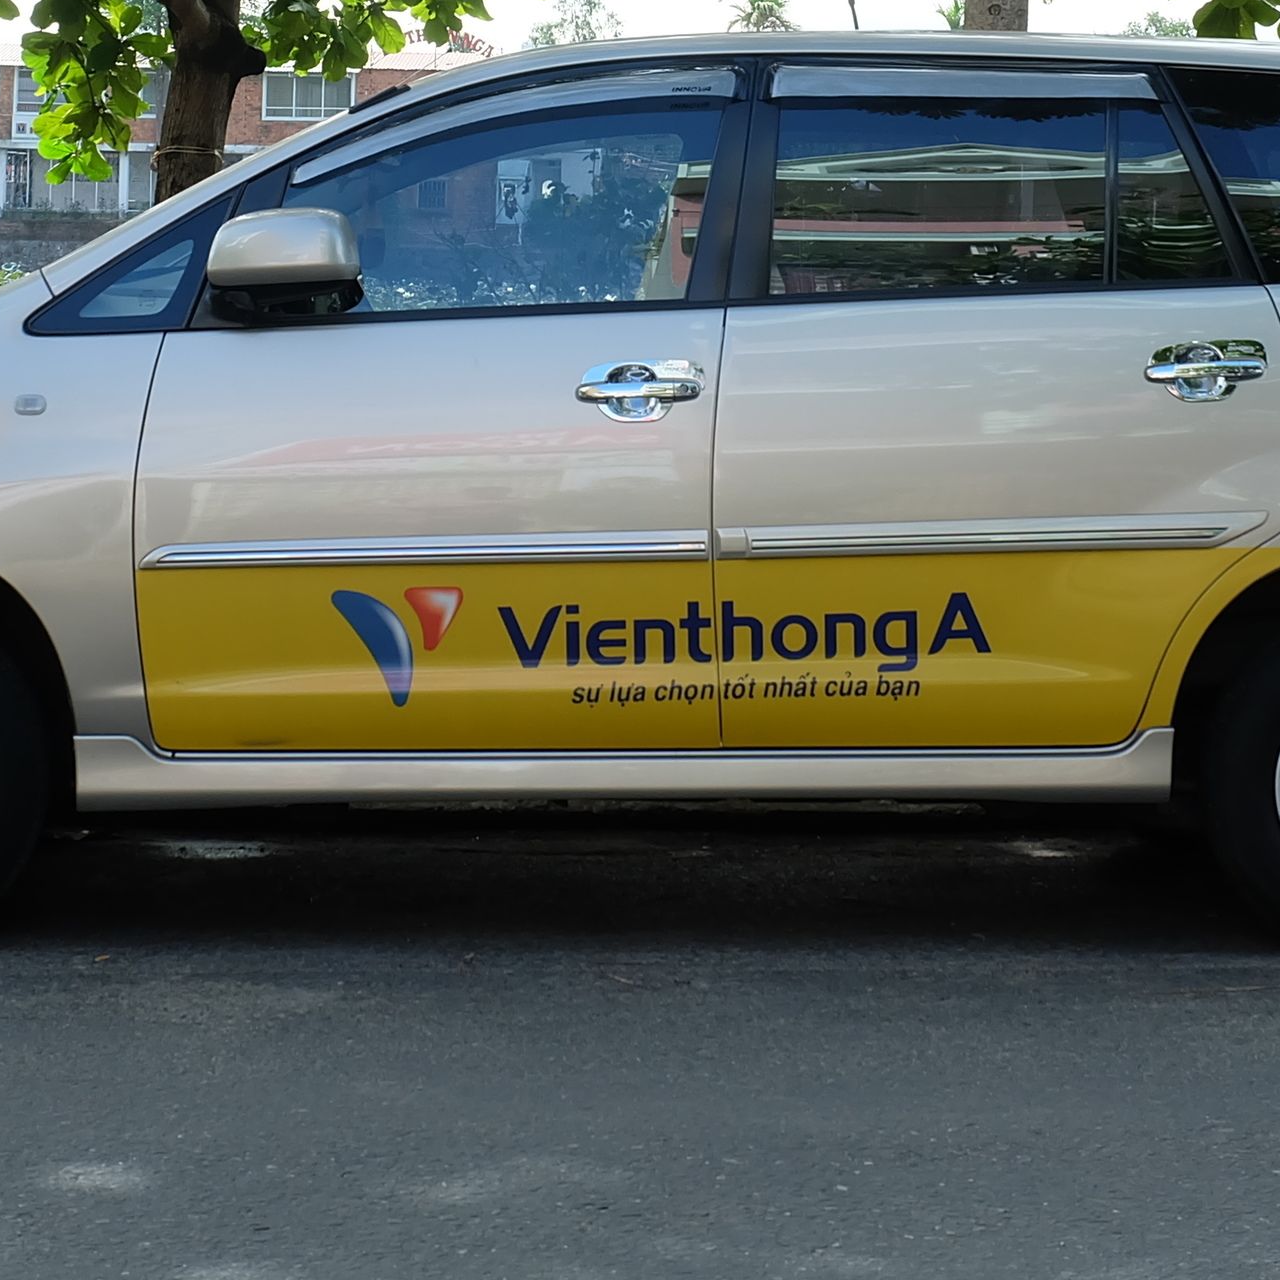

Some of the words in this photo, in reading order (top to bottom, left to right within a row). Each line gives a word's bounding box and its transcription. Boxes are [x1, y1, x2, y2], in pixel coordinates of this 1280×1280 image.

[671, 85, 713, 93] INNOVA
[571, 683, 604, 708] sự
[609, 681, 647, 708] lựa
[654, 679, 715, 705] chọn
[723, 673, 757, 700] tốt
[763, 672, 818, 699] nhất
[824, 671, 868, 697] của
[876, 675, 921, 701] bạn
